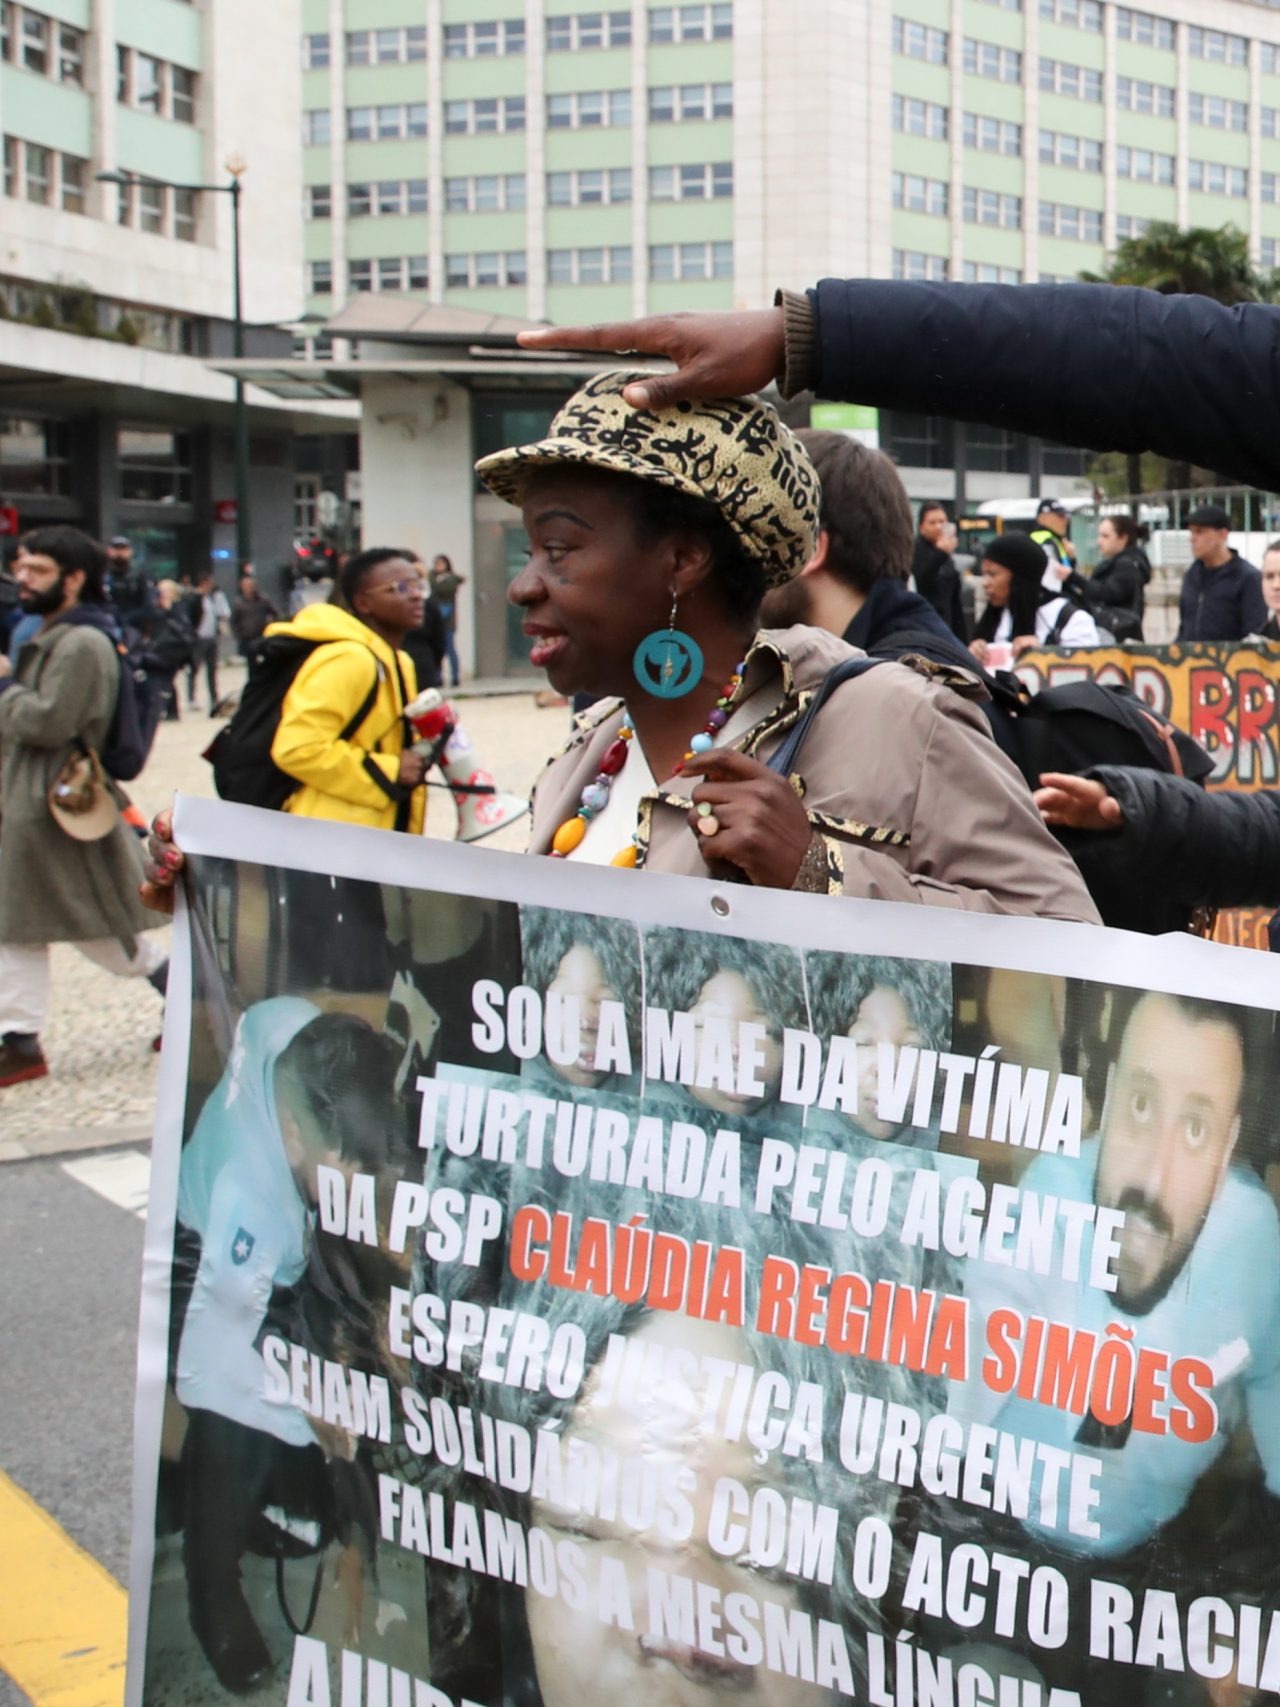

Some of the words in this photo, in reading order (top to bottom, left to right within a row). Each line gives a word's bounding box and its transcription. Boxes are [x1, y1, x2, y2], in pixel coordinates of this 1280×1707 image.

[416, 1075, 741, 1206] TURTURADA
[755, 1136, 891, 1238] PELO
[899, 1168, 1126, 1293] AGENTE
[471, 979, 581, 1066] SOU
[593, 998, 632, 1075] A
[780, 1027, 859, 1115] DA
[875, 1044, 1083, 1158] VITÍMA
[316, 1164, 379, 1248] DA
[388, 1180, 503, 1268] PSP
[508, 1203, 746, 1328] CLAÚDIA
[755, 1253, 970, 1382] REGINA
[982, 1306, 1219, 1444] SIMÕES
[388, 1285, 587, 1399] ESPERO
[592, 1333, 824, 1465] JUSTIÇA
[839, 1391, 1103, 1540] URGENTE
[378, 1473, 588, 1612] FALAMOS
[599, 1556, 634, 1630] A
[647, 1566, 855, 1697] MESMA
[401, 1387, 698, 1542] SOLIDÁRIOS
[707, 1477, 839, 1585] COM
[852, 1516, 893, 1599] O
[902, 1530, 1069, 1649] ACTO
